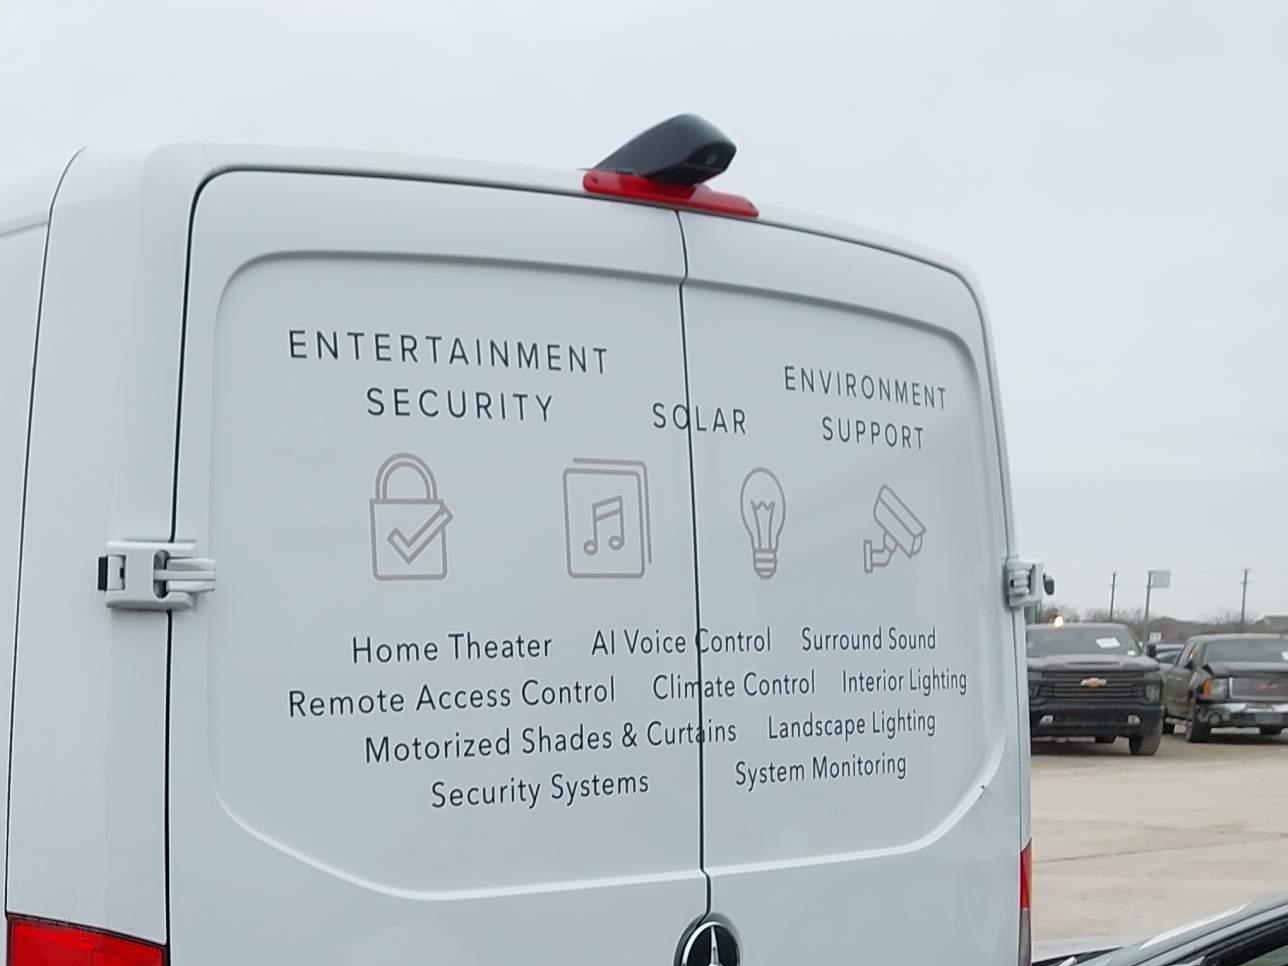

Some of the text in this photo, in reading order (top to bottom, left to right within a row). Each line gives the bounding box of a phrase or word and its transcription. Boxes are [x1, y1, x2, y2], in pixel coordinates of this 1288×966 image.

[289, 330, 607, 374] ENTERTAINMENT
[367, 387, 552, 422] SECURITY
[784, 366, 945, 409] ENVIRONMENT
[653, 402, 745, 434] SOLAR
[822, 416, 923, 450] SUPPORT
[353, 632, 552, 664] Home Theater
[624, 629, 686, 654] Voice
[695, 626, 771, 653] Control
[802, 626, 935, 651] Surround Sound
[289, 675, 614, 717] Remote Access Control
[653, 669, 814, 700] Climate Control
[843, 667, 966, 696] Interior Lighting
[366, 719, 736, 763] Motorized Shades & Curtains
[769, 709, 935, 742] Landscape Lighting
[736, 752, 905, 792] System Monitoring
[432, 773, 648, 809] Security Systems
